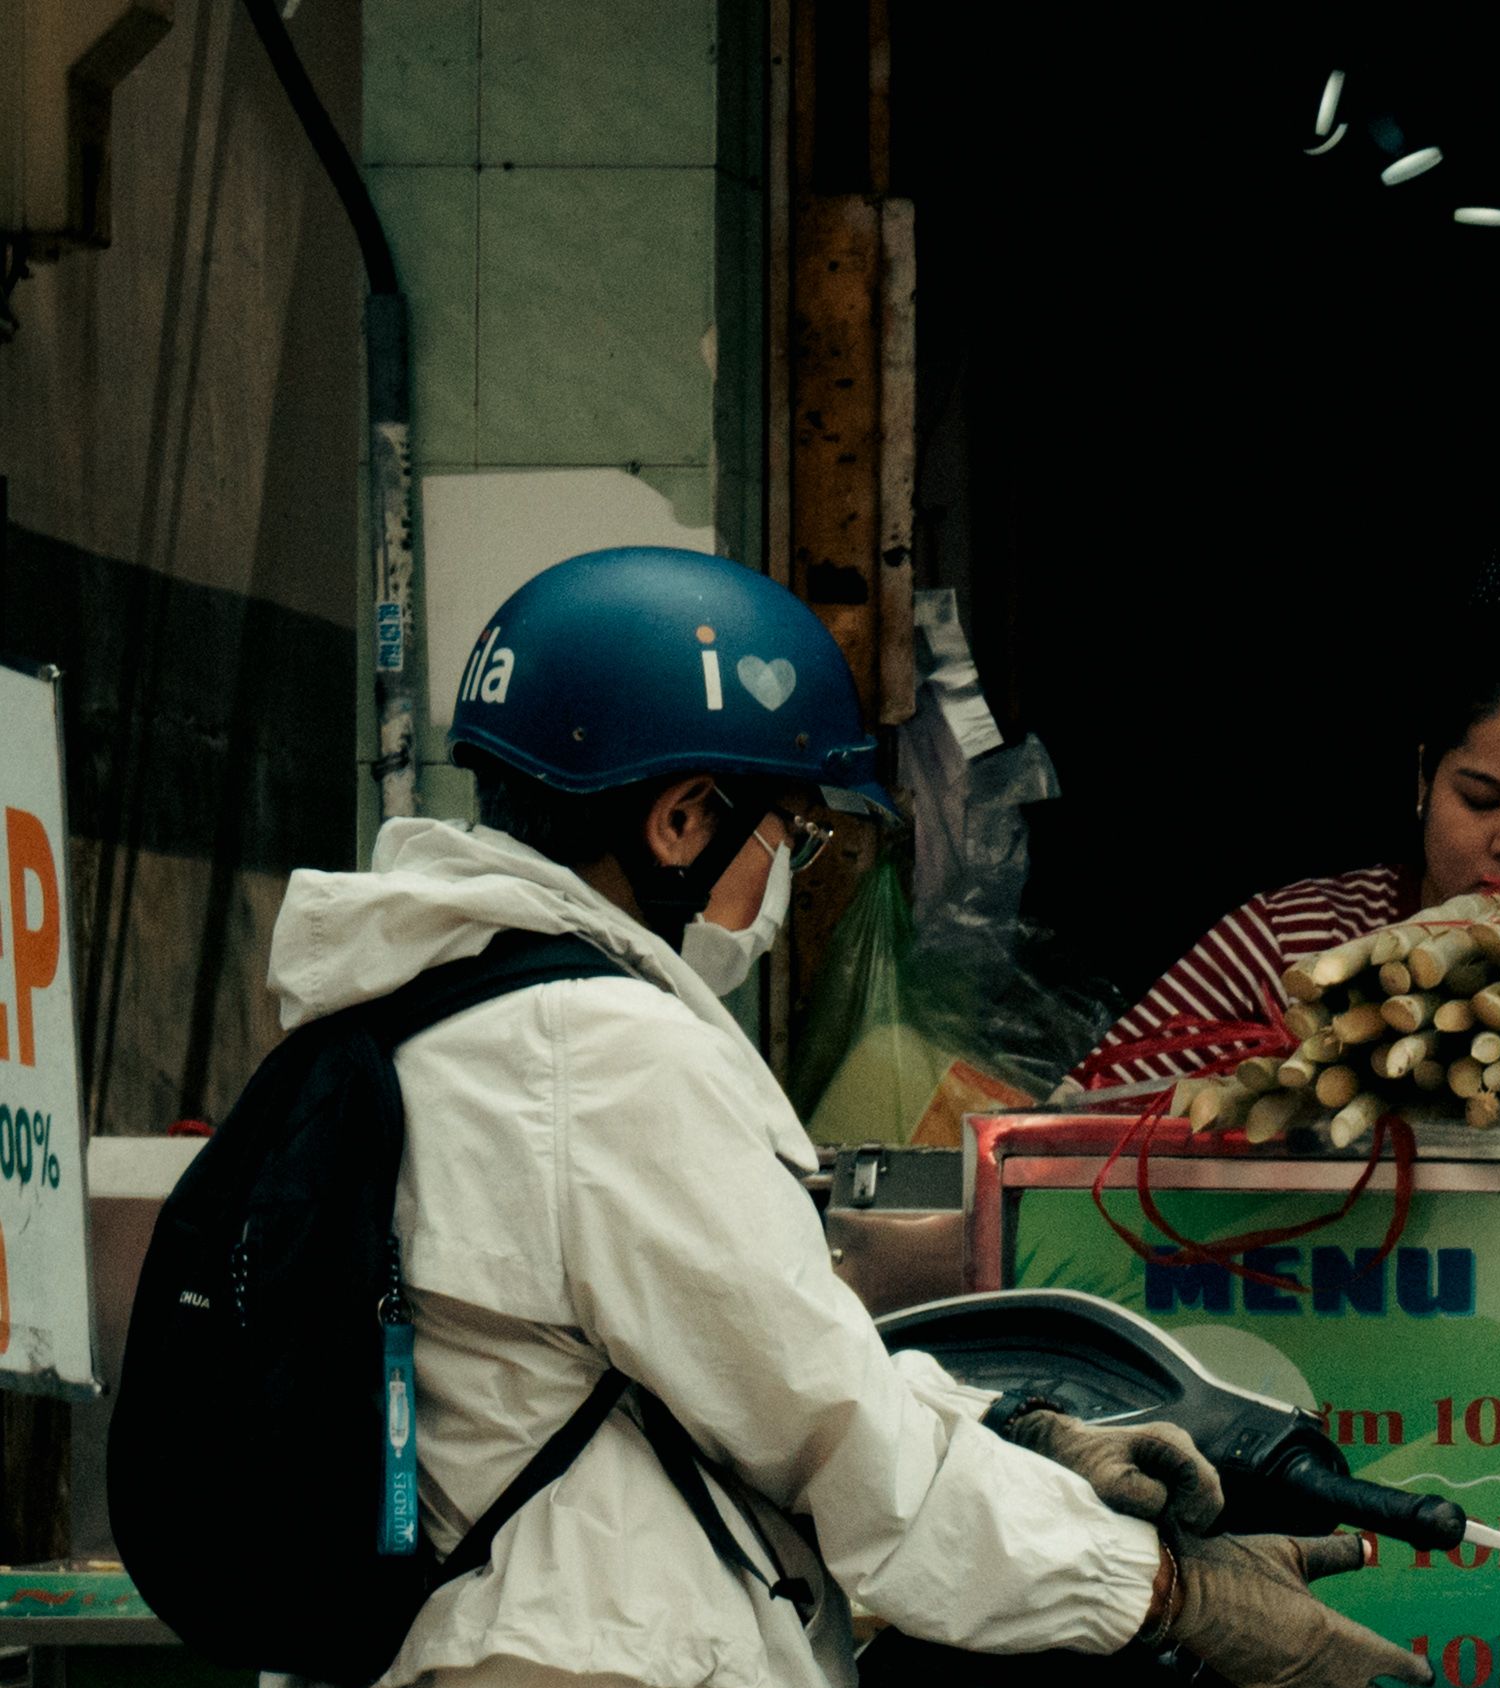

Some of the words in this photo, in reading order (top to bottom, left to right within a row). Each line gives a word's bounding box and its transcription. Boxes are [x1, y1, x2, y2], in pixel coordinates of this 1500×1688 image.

[461, 626, 515, 704] ila
[0, 806, 61, 1068] P
[1143, 1245, 1477, 1319] MENU
[393, 1471, 407, 1552] LOURDES
